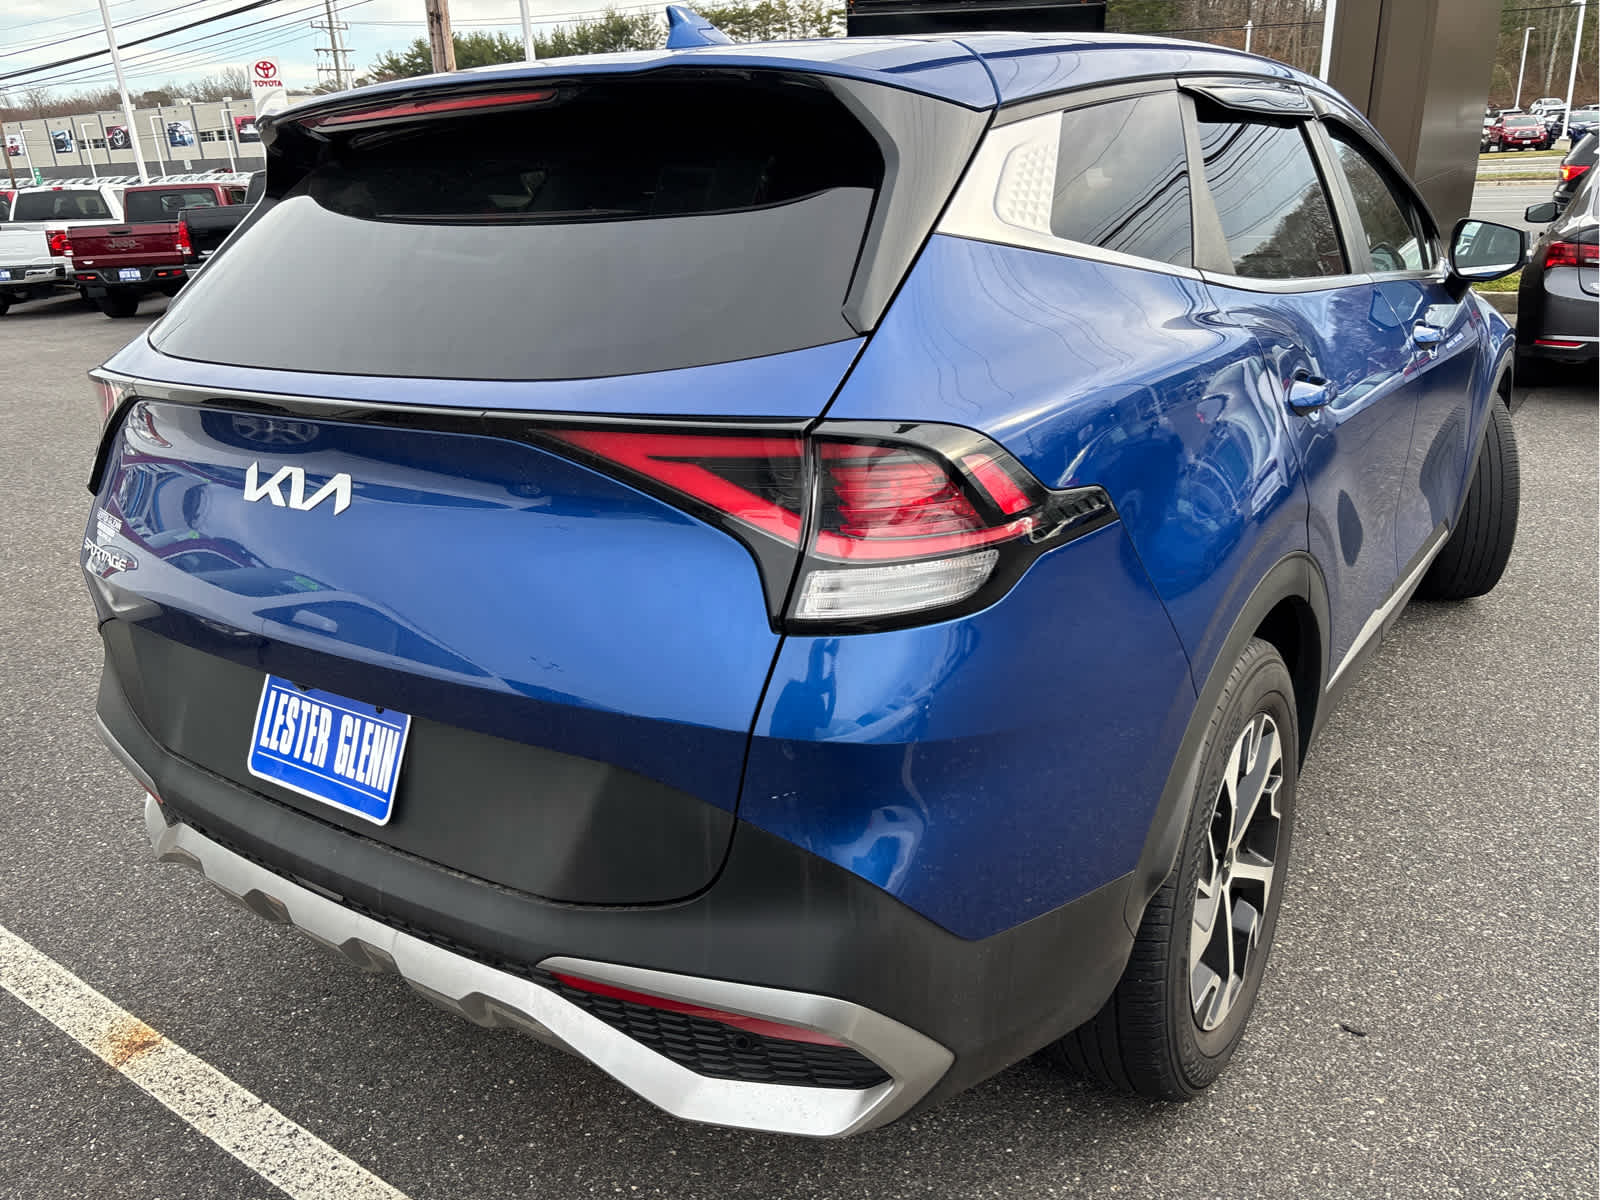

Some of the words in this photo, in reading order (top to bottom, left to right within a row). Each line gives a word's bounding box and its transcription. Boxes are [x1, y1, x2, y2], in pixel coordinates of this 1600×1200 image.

[243, 461, 352, 516] KIA
[84, 536, 128, 572] SPORTAGE
[259, 689, 332, 769] LESTER
[333, 714, 401, 793] GLENN
